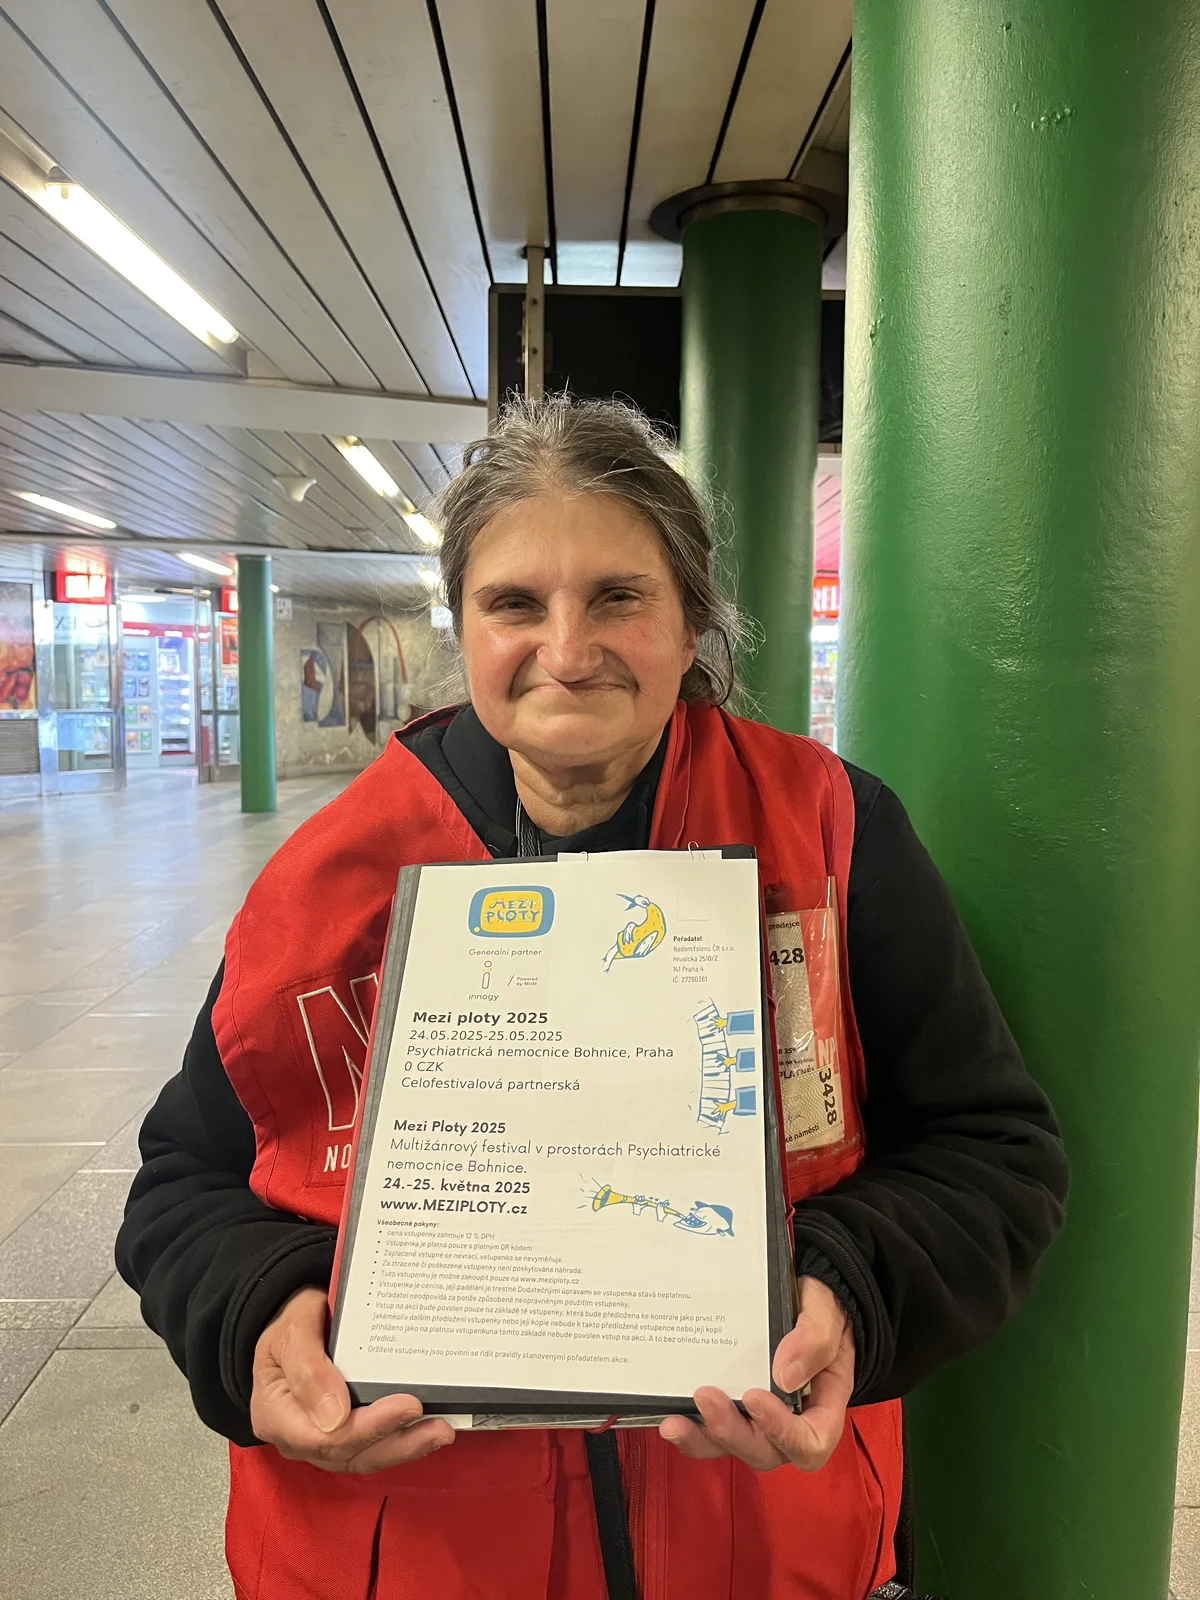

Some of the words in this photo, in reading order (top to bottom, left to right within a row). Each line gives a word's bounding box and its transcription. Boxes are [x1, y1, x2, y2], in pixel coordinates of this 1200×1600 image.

[489, 899, 534, 909] MEZI
[486, 910, 540, 922] PLOTY
[768, 921, 800, 930] prodejce
[468, 993, 499, 1001] innogy
[412, 1012, 451, 1022] Mezi
[457, 1011, 500, 1026] ploty
[506, 1012, 548, 1023] 2025
[409, 1029, 562, 1041] 24.05.2025-25.05.2025
[406, 1045, 493, 1058] Psychiatrická
[497, 1046, 569, 1057] nemocnice
[574, 1047, 630, 1057] Bohnice,
[635, 1047, 673, 1057] Praha
[403, 1061, 413, 1071] 0
[416, 1061, 443, 1071] CZK
[400, 1077, 503, 1089] Celofestivalová
[507, 1079, 579, 1091] partnerská
[819, 1067, 838, 1126] 3428
[393, 1119, 427, 1131] Mezi
[431, 1119, 467, 1135] Ploty
[470, 1121, 506, 1133] 2025
[794, 1123, 820, 1140] náměstí
[389, 1136, 478, 1155] Multižánrový
[481, 1138, 530, 1153] festival
[535, 1145, 542, 1153] v
[547, 1141, 622, 1158] prostorách
[628, 1142, 720, 1159] Psychiatrické
[386, 1159, 463, 1171] nemocnice
[467, 1158, 527, 1173] Bohnice.
[382, 1177, 435, 1190] 24.-25.
[440, 1177, 490, 1192] května
[494, 1181, 530, 1193] 2025
[379, 1197, 527, 1213] www.MEZIPLOTY.cz
